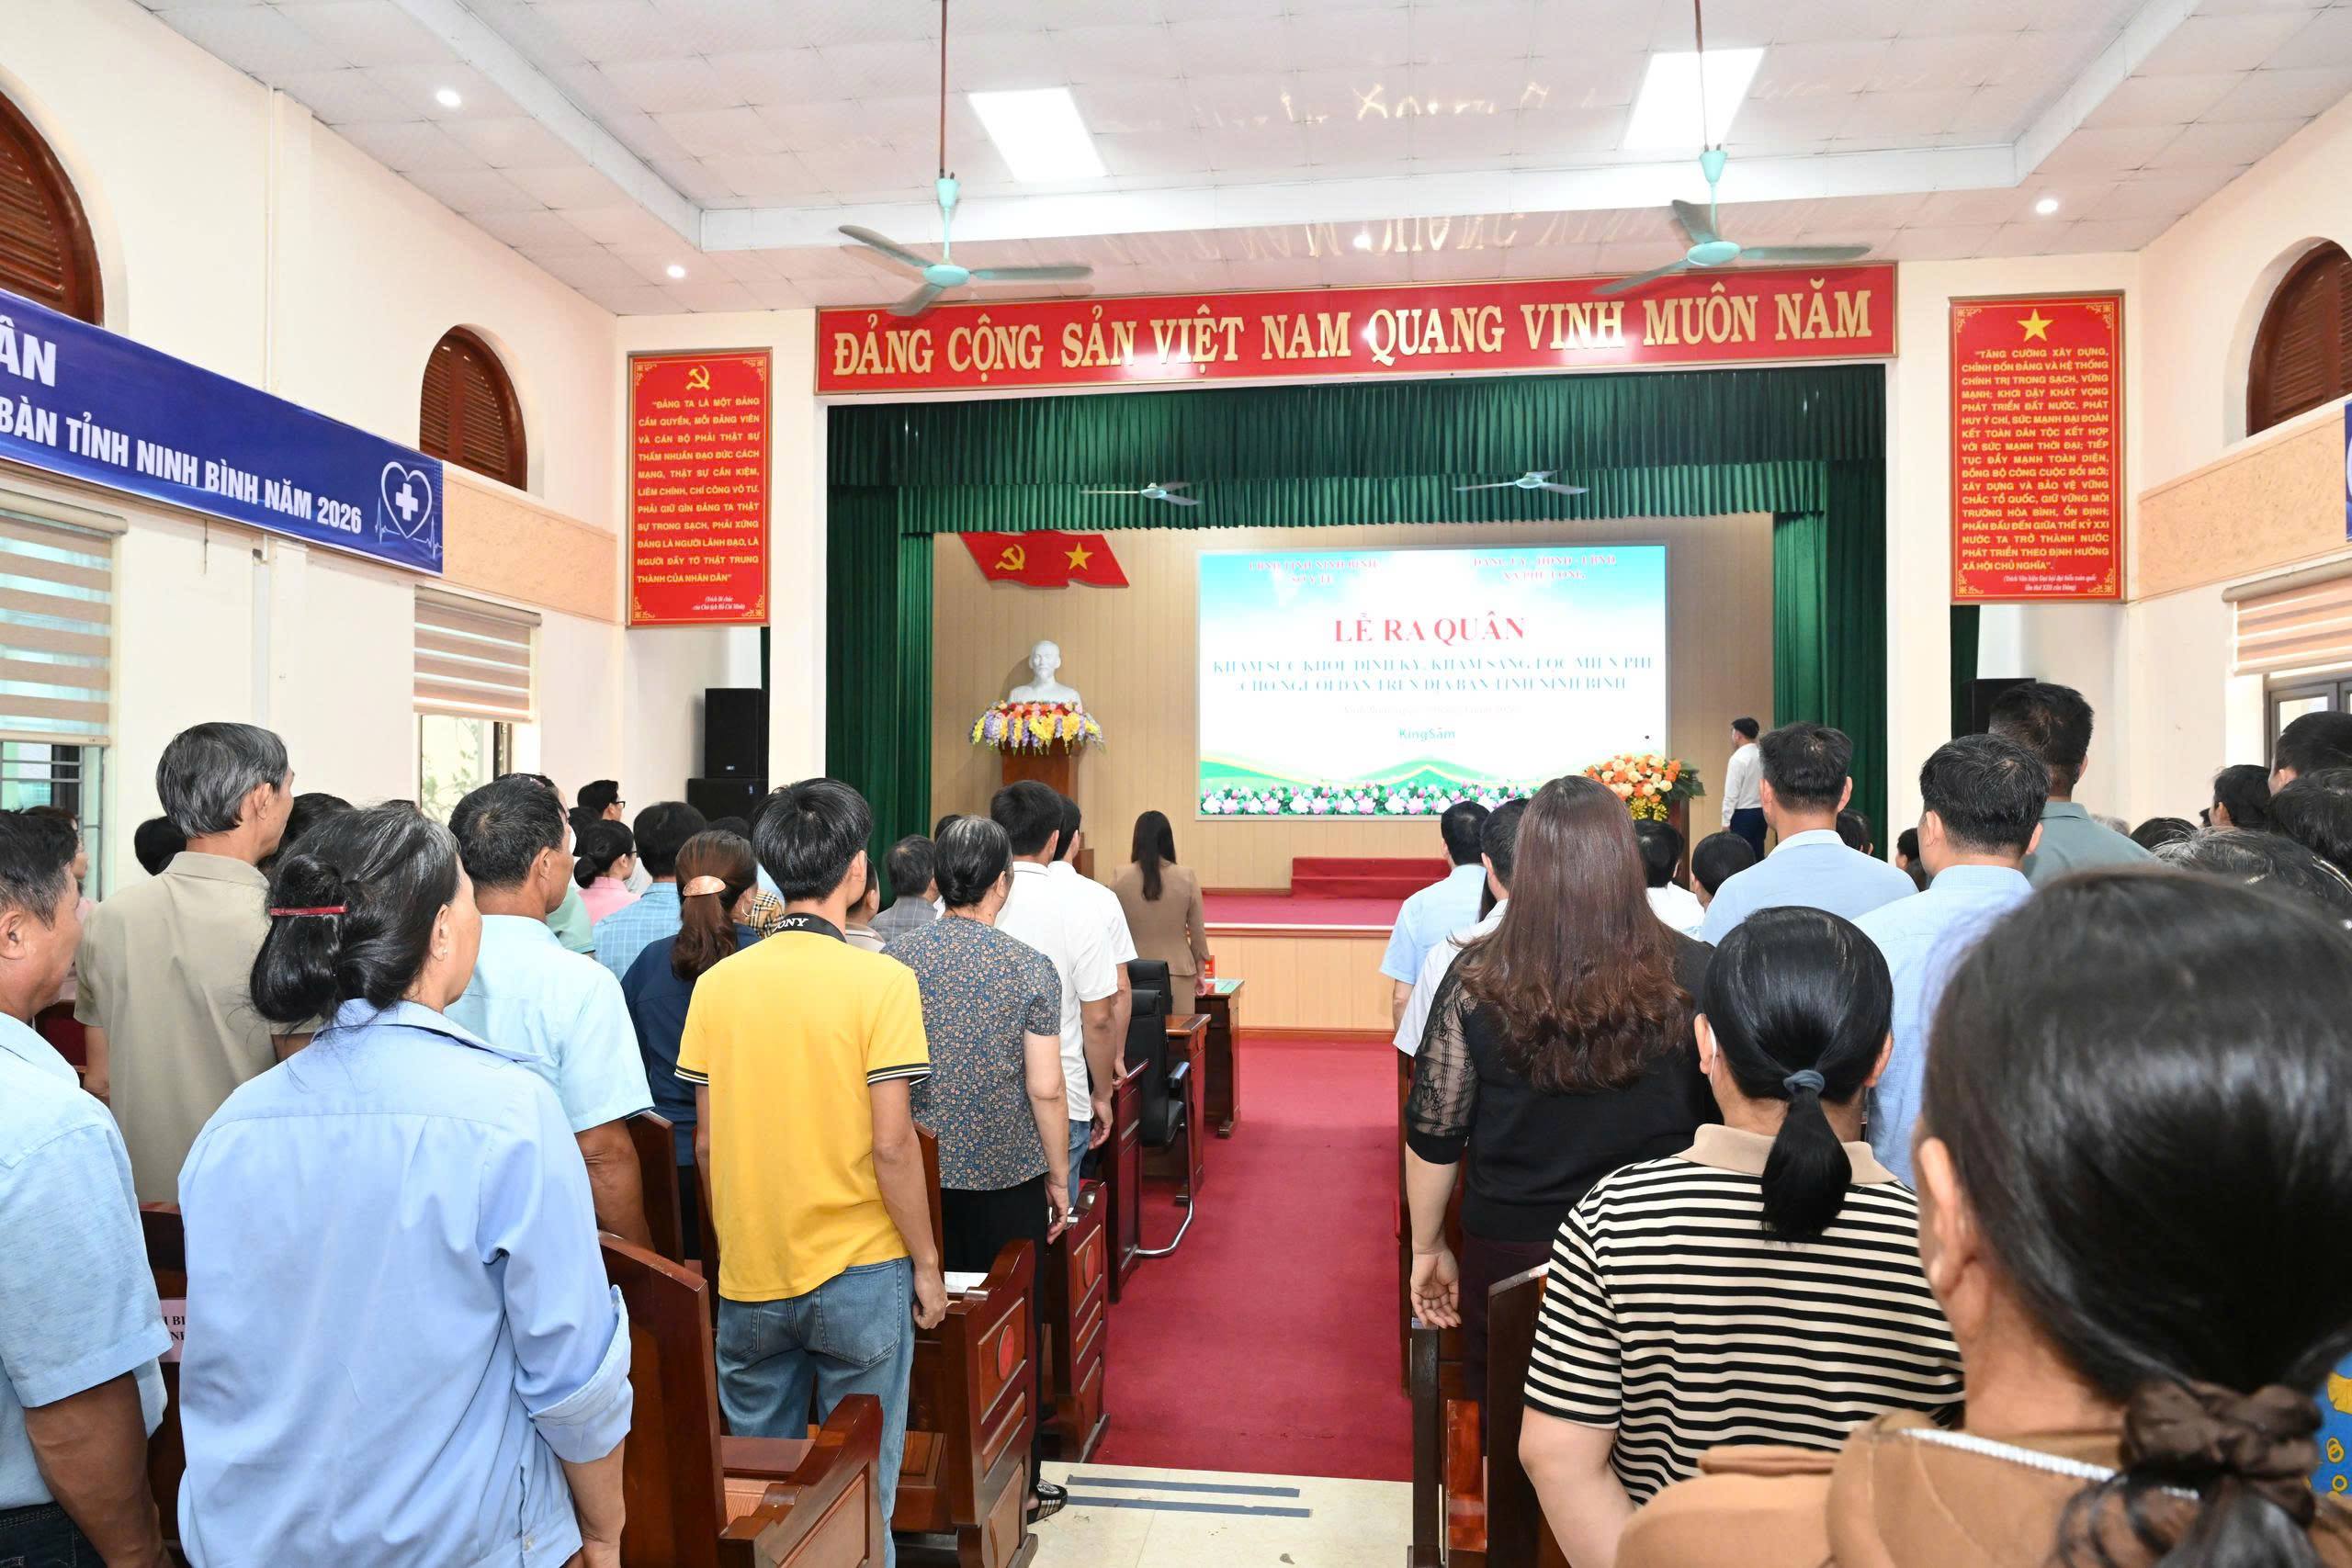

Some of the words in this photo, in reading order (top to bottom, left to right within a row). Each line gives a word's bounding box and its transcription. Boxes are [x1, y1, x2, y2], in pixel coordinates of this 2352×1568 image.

[833, 314, 933, 376] ĐẢNG
[947, 313, 1043, 382] CỘNG
[1061, 304, 1137, 367] SẢN
[1149, 304, 1245, 374] VIỆT
[1261, 311, 1351, 359] NAM
[1367, 306, 1505, 366] QUANG
[1521, 300, 1625, 350] VINH
[1643, 282, 1758, 346] MUÔN
[1774, 277, 1871, 341] NĂM
[0, 394, 57, 446] BÀN
[66, 412, 129, 467] TỈNH
[137, 439, 198, 487] NINH
[205, 457, 258, 504] BÌNH
[265, 479, 311, 519] NĂM
[318, 496, 362, 534] 2026
[1385, 619, 1426, 642] RA
[1433, 610, 1527, 647] QUÂN
